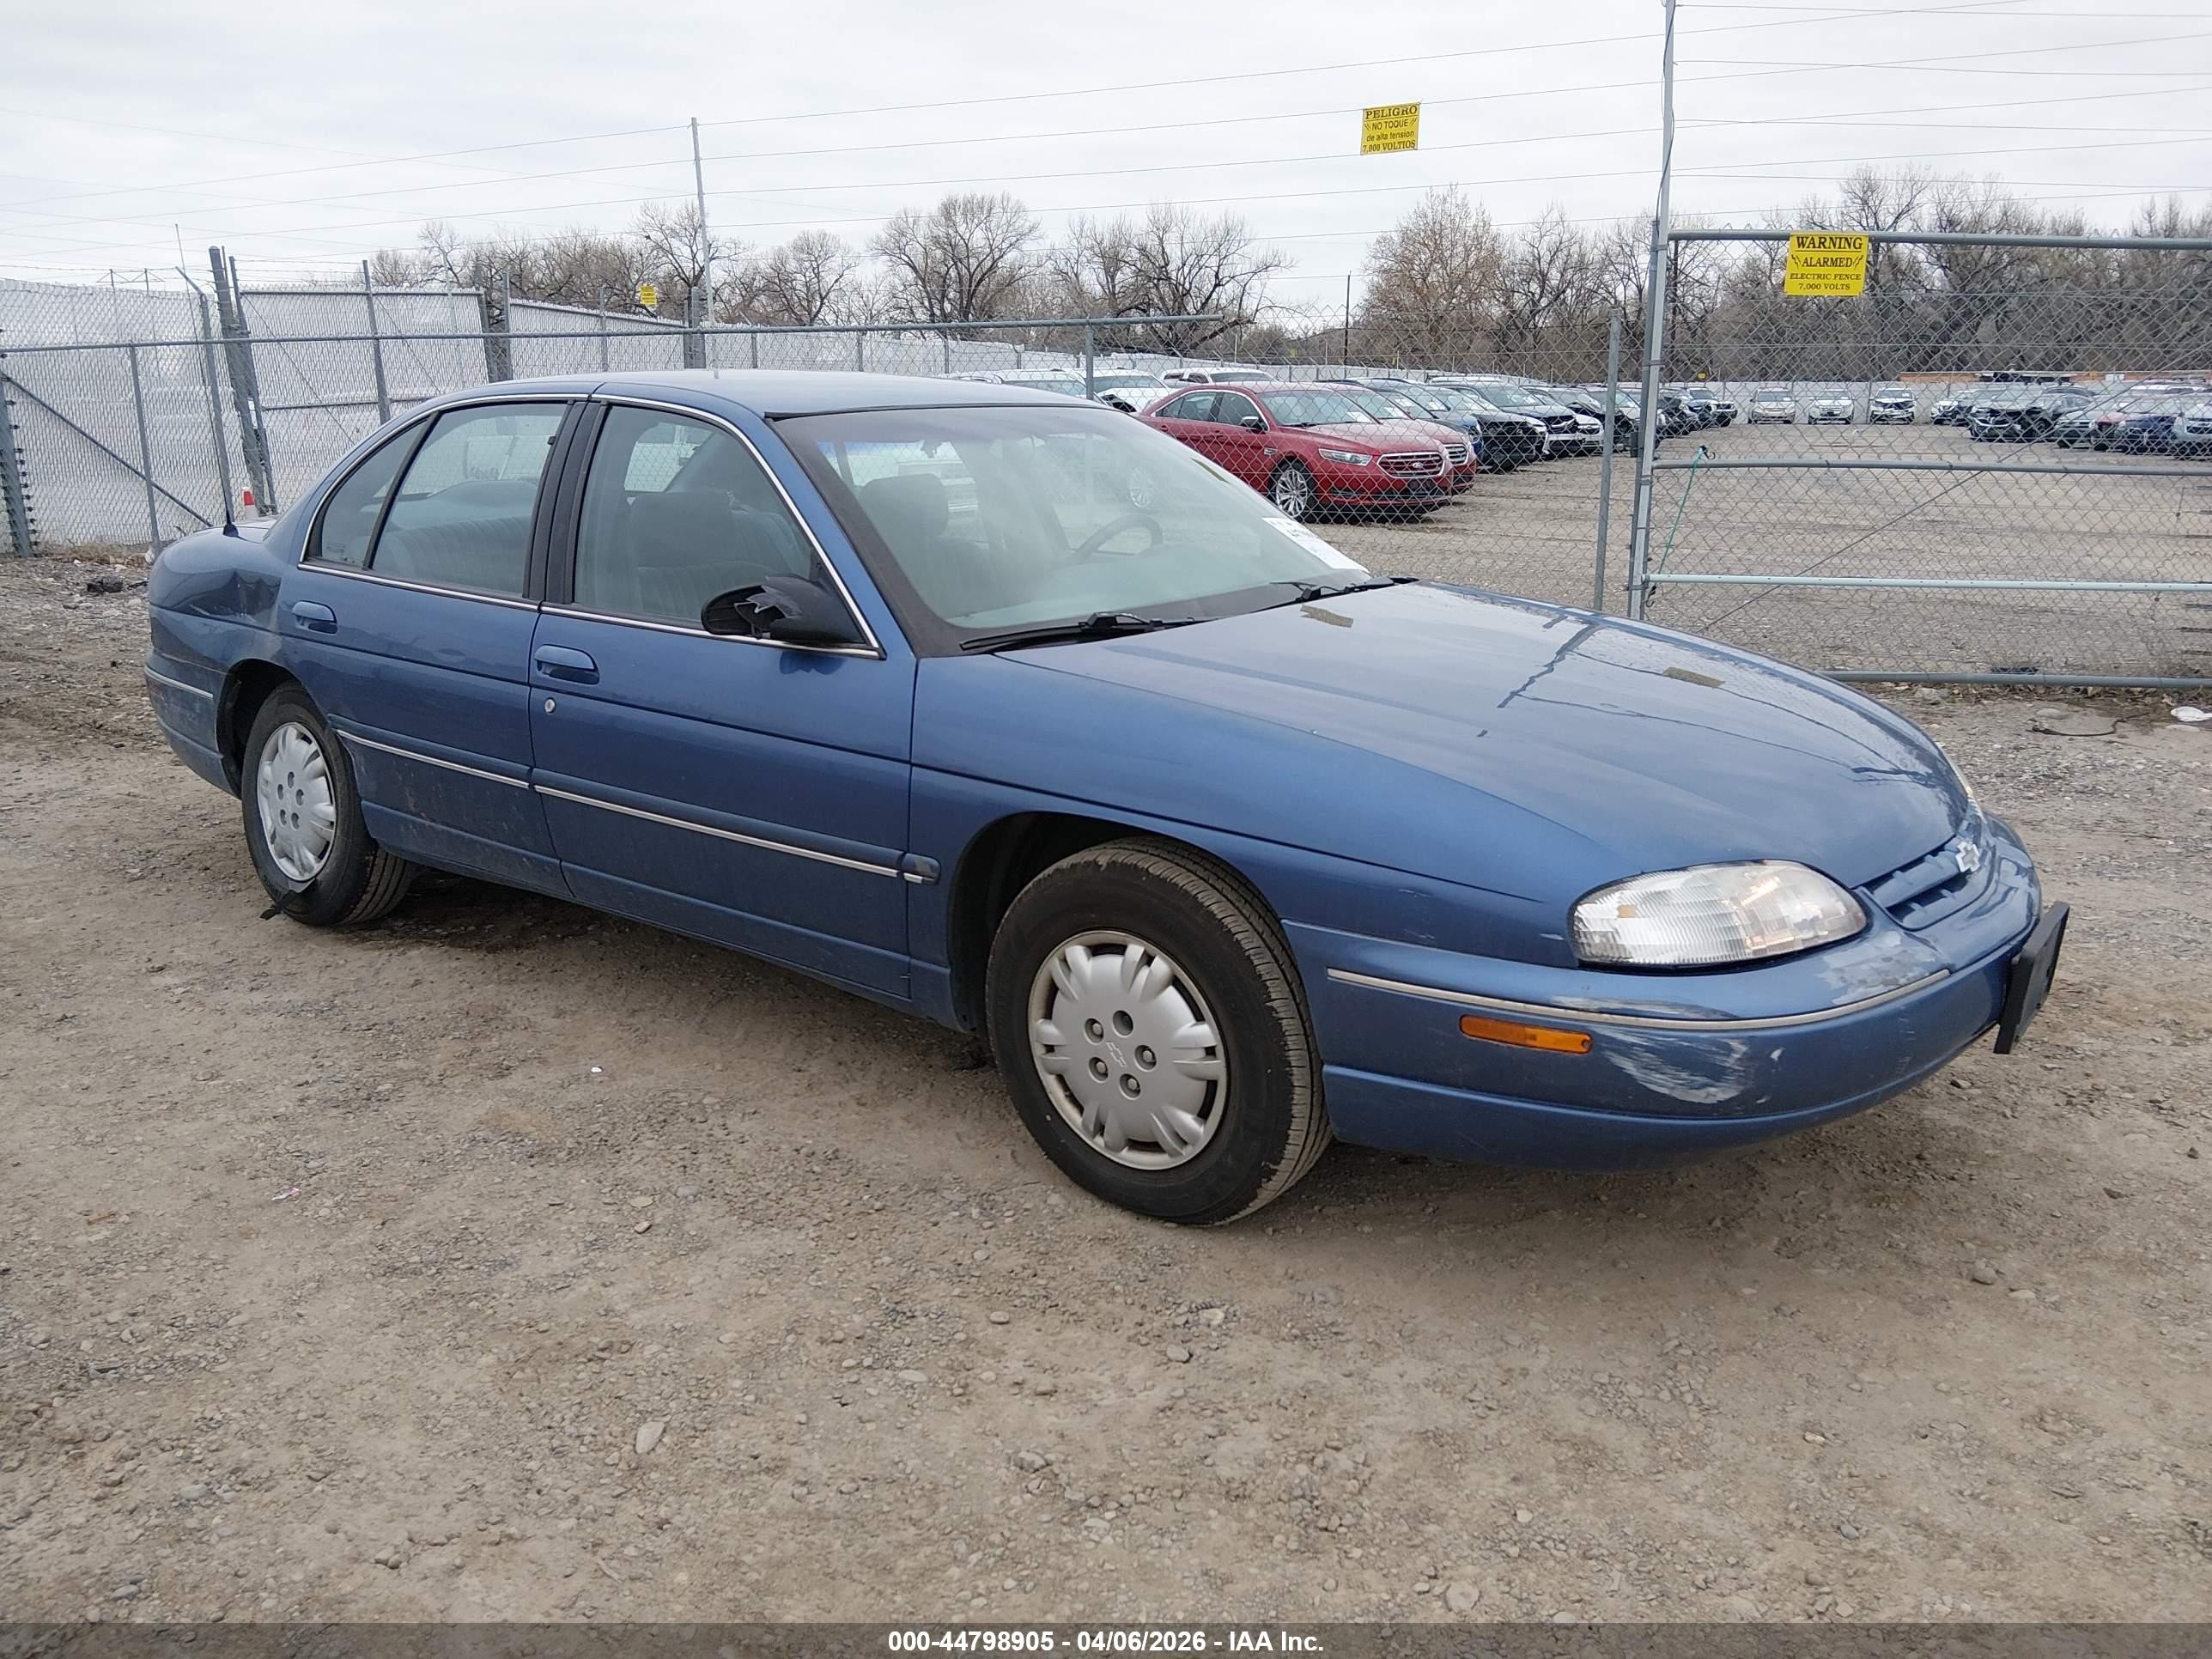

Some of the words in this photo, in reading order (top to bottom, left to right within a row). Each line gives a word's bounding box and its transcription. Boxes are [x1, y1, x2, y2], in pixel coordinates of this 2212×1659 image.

[1365, 105, 1418, 119] PELIGRO
[1372, 122, 1382, 131] NO
[1383, 118, 1408, 129] TOQUE
[1376, 132, 1389, 141] alta
[1382, 139, 1416, 151] VOLTIOS
[1796, 236, 1863, 250] WARNING
[1802, 257, 1853, 268] ALARMED
